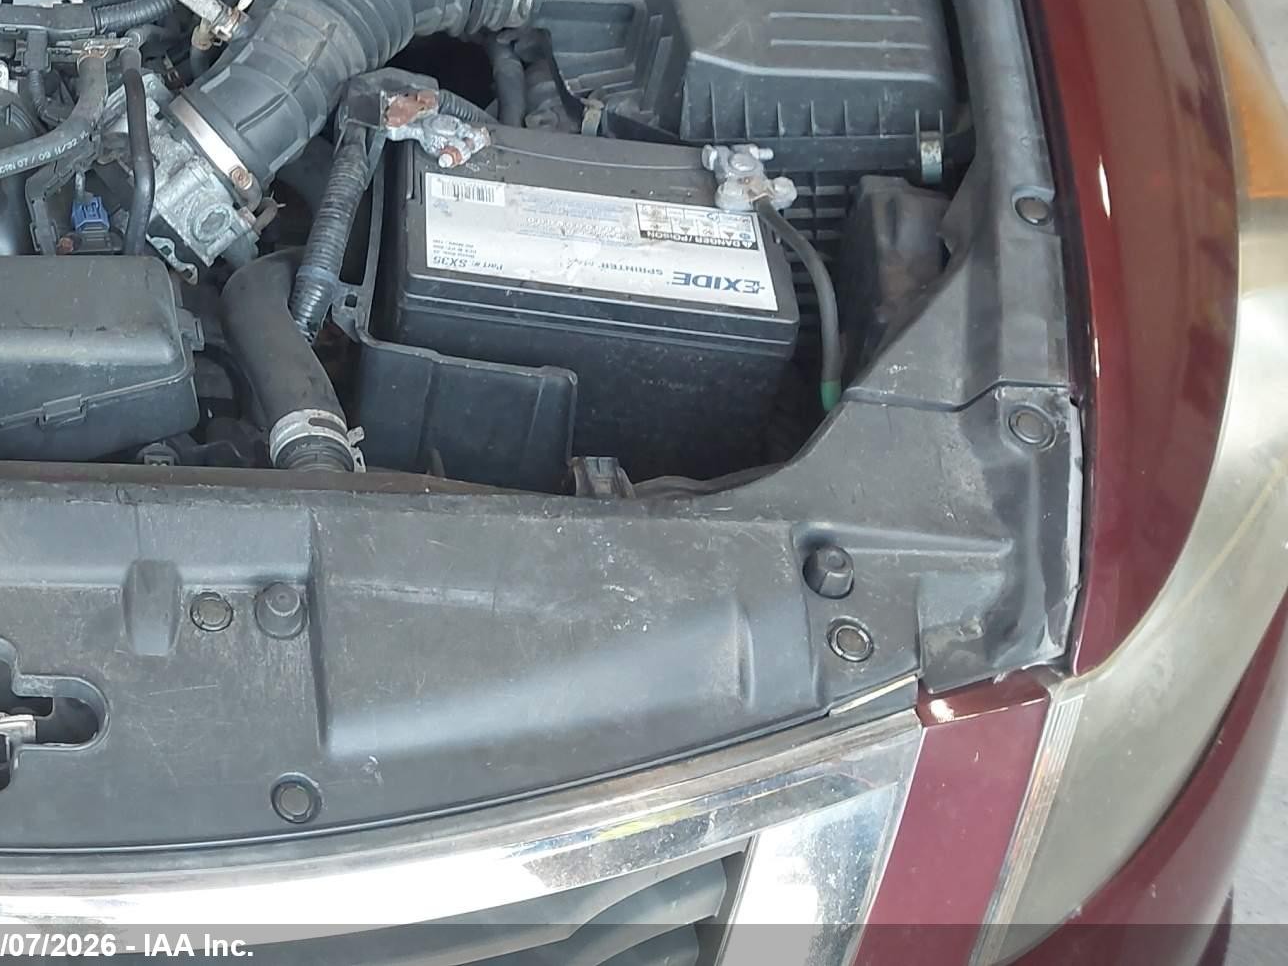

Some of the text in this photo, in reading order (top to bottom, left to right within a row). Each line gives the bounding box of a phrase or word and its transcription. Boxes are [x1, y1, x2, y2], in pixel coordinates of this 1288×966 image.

[695, 235, 741, 246] DANGER
[432, 255, 469, 268] SX35
[671, 271, 766, 295] EXIDE
